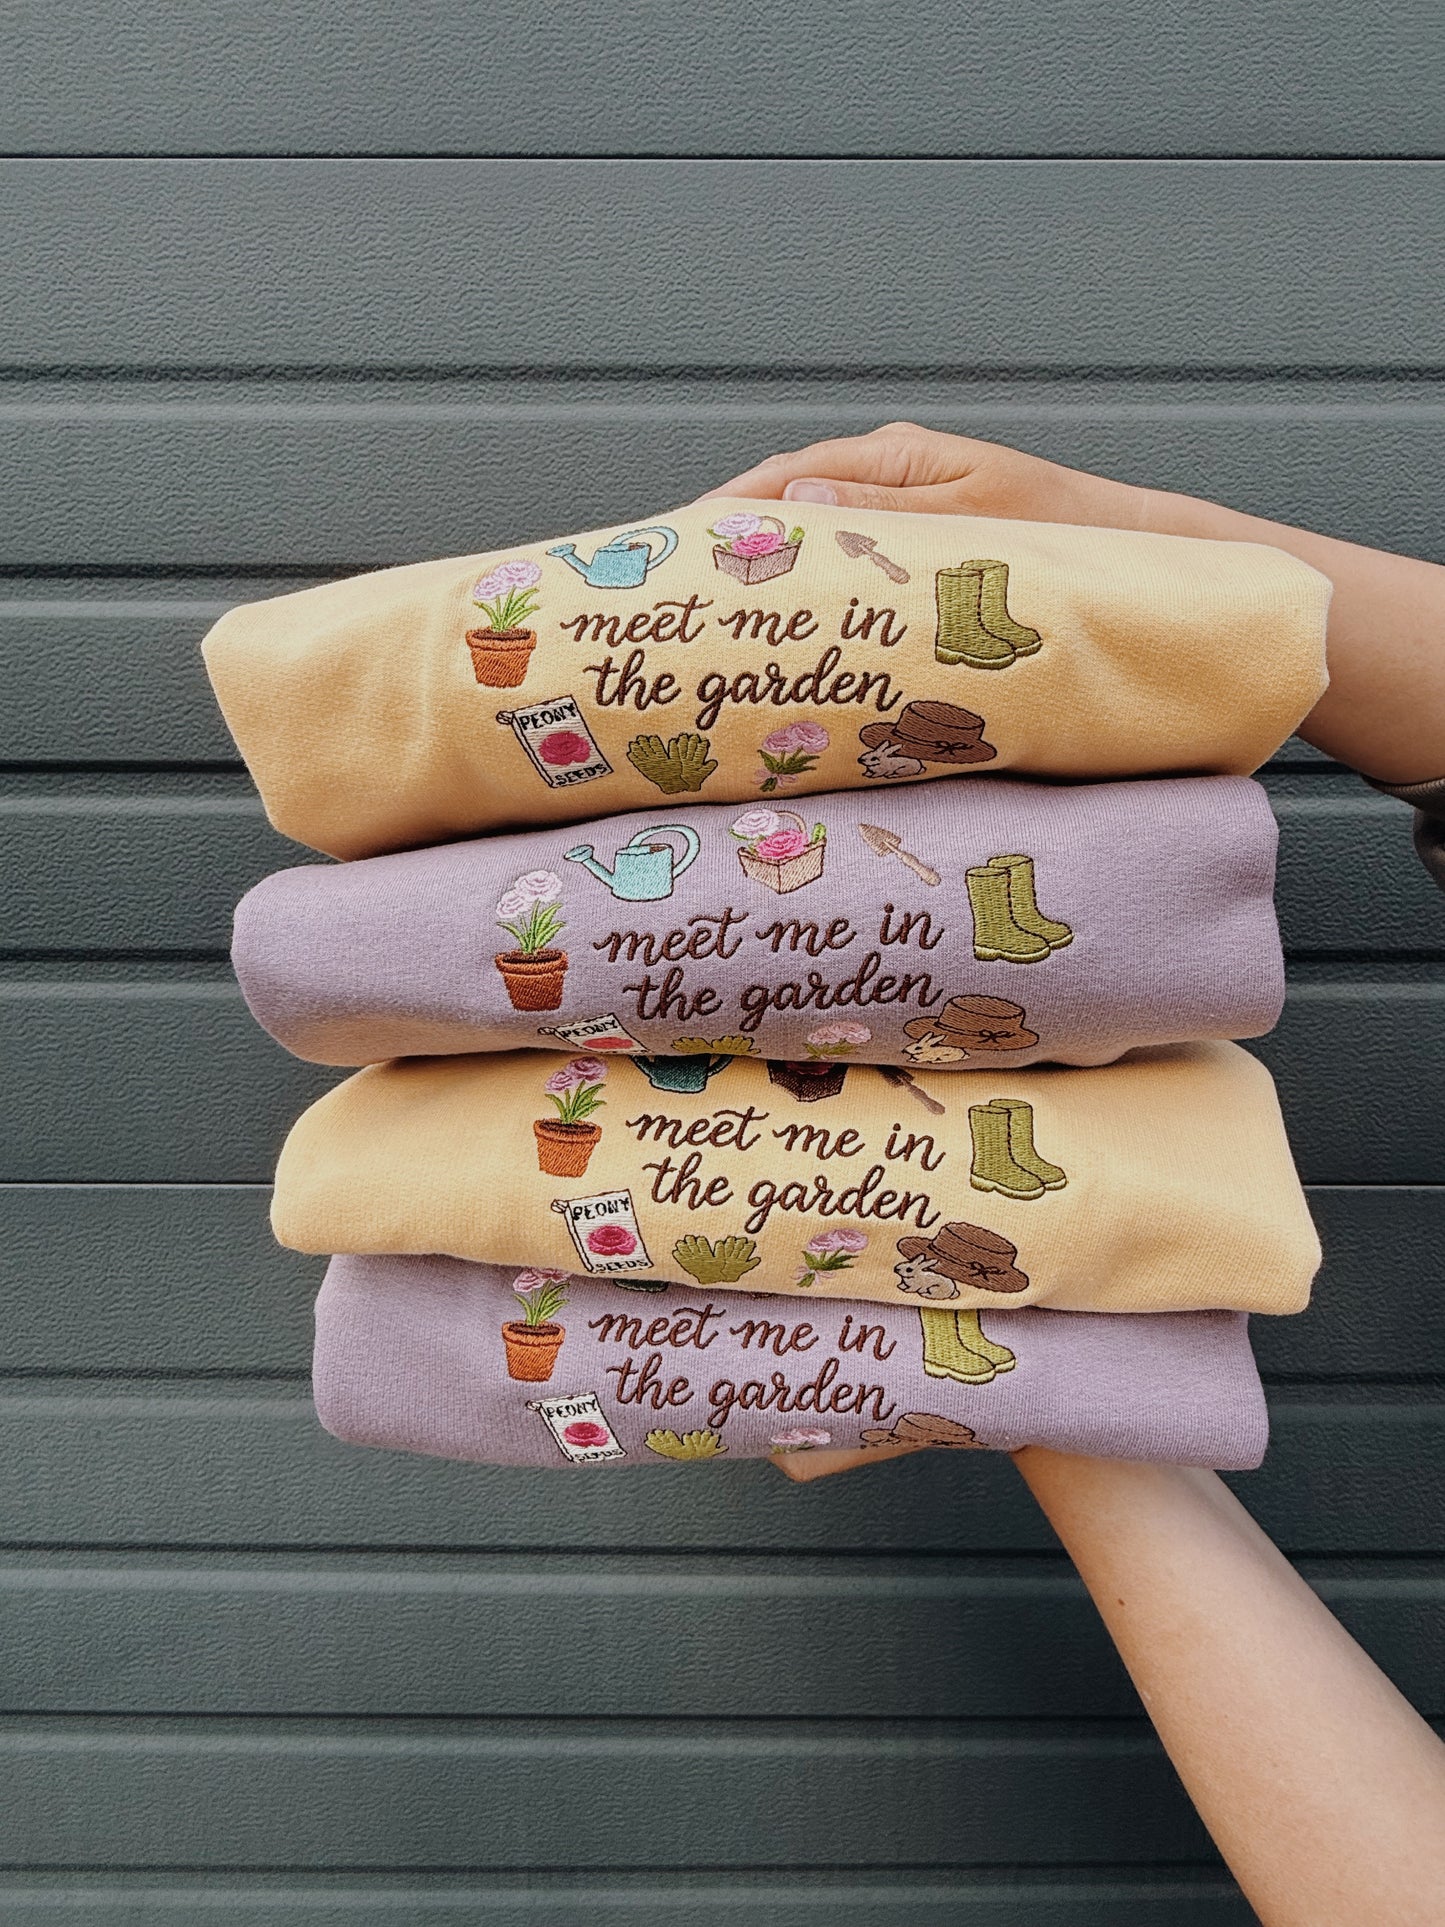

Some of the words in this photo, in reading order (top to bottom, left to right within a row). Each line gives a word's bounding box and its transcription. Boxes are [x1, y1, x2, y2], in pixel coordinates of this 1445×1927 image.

[560, 594, 715, 648] meet
[718, 609, 819, 647] me
[840, 597, 909, 648] in
[518, 702, 577, 731] PEONY
[582, 648, 682, 711] the
[696, 645, 904, 732] garden
[554, 763, 608, 786] SEEDS
[593, 907, 750, 967] meet
[754, 918, 858, 958] me
[879, 903, 946, 951] in
[622, 965, 724, 1023] the
[739, 950, 945, 1034] garden
[560, 1019, 619, 1038] PEONY
[625, 1105, 770, 1151] meet
[773, 1123, 866, 1160] me
[884, 1123, 947, 1172] in
[572, 1196, 630, 1221] PEONY
[642, 1151, 734, 1211] the
[744, 1164, 942, 1235] garden
[587, 1303, 727, 1350] meet
[729, 1319, 820, 1357] me
[838, 1314, 898, 1361] in
[545, 1399, 600, 1419] PEONY
[605, 1352, 695, 1411] the
[708, 1357, 898, 1430] garden
